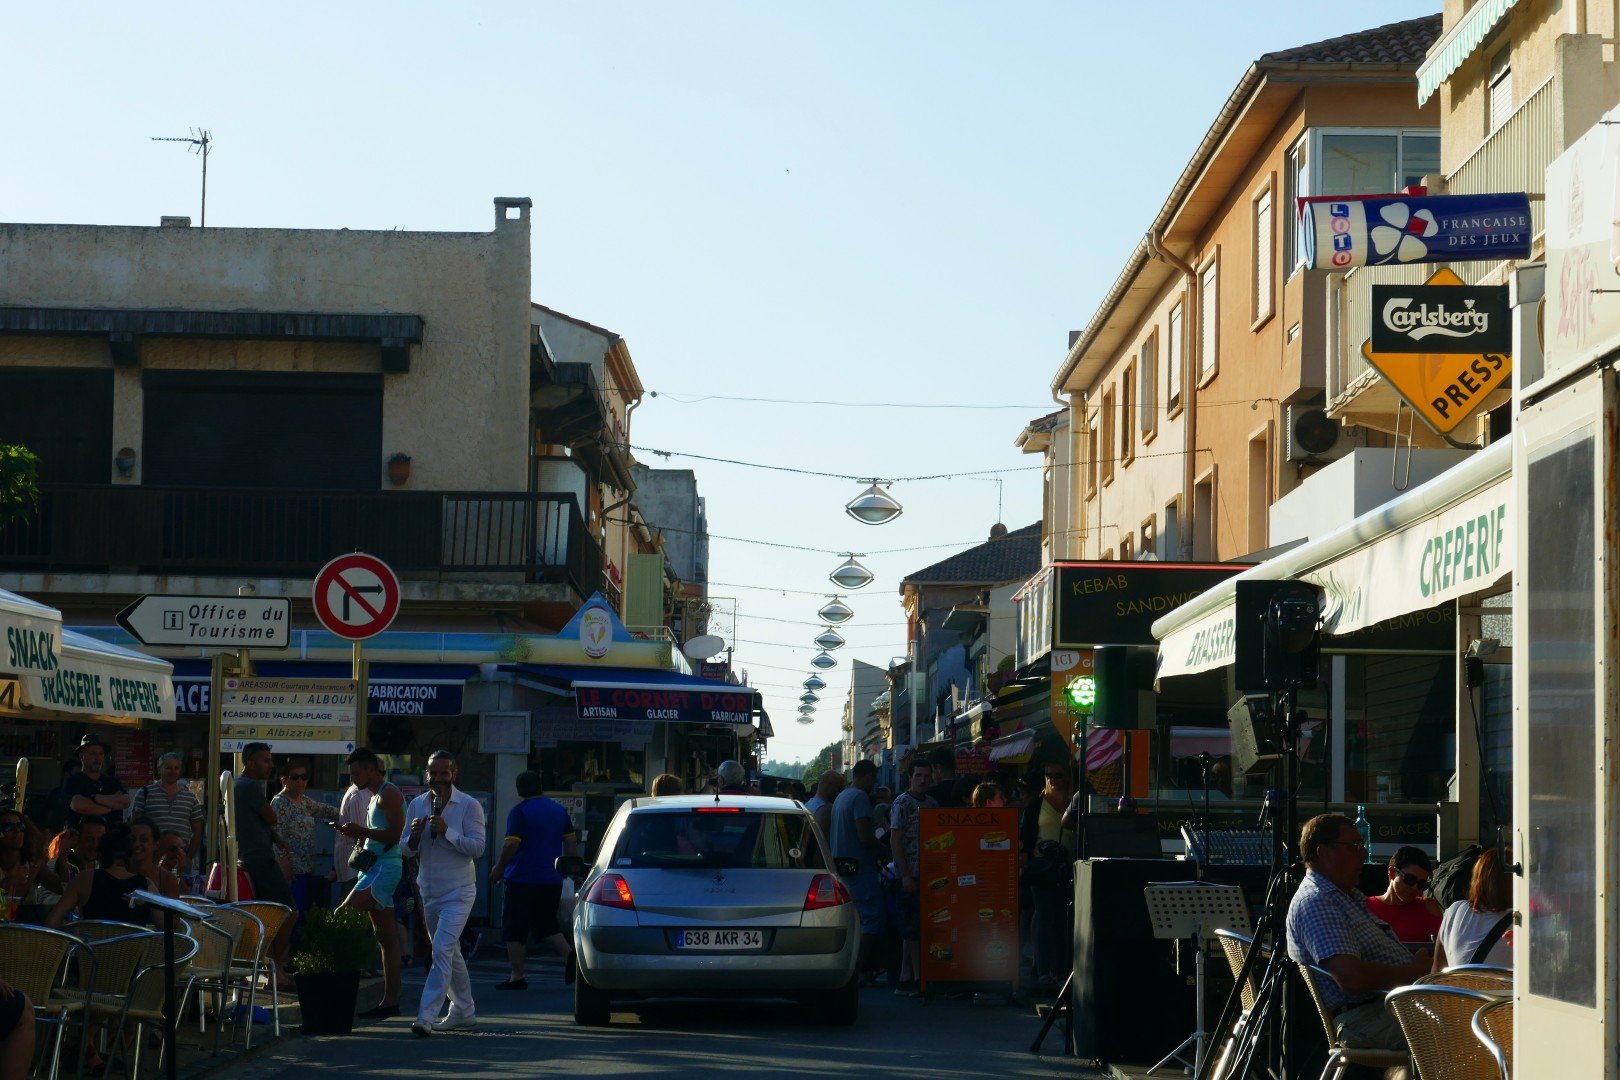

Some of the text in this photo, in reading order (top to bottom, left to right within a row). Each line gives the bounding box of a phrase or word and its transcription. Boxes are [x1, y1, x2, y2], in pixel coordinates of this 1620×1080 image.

[1330, 203, 1352, 266] LOTO
[1449, 233, 1520, 246] DES JEUX
[1381, 297, 1489, 334] Carlsberg
[1431, 353, 1511, 420] PRESS
[1419, 503, 1506, 598] CREPERIE
[1072, 574, 1128, 596] KEBAB
[188, 604, 284, 621] Office du
[189, 622, 275, 639] Tourisme
[7, 626, 58, 671] SNACK
[1054, 653, 1072, 666] ICI
[41, 669, 104, 709] BRASSERIE
[109, 676, 162, 714] CREPERIE
[242, 693, 355, 706] Agence J. ALBOUY
[368, 685, 437, 699] FABRICATION
[579, 688, 747, 711] LE CORNET D'OR
[378, 700, 424, 714] MAISON
[583, 707, 749, 723] ARTISAN GLACIER FABRICANT
[227, 711, 332, 720] CASINO DE VALRAS-PLAGE
[266, 728, 314, 738] Albizzia
[937, 813, 1000, 825] SNACK
[1379, 822, 1431, 838] GLACES
[685, 932, 760, 946] 638 AKR 34
